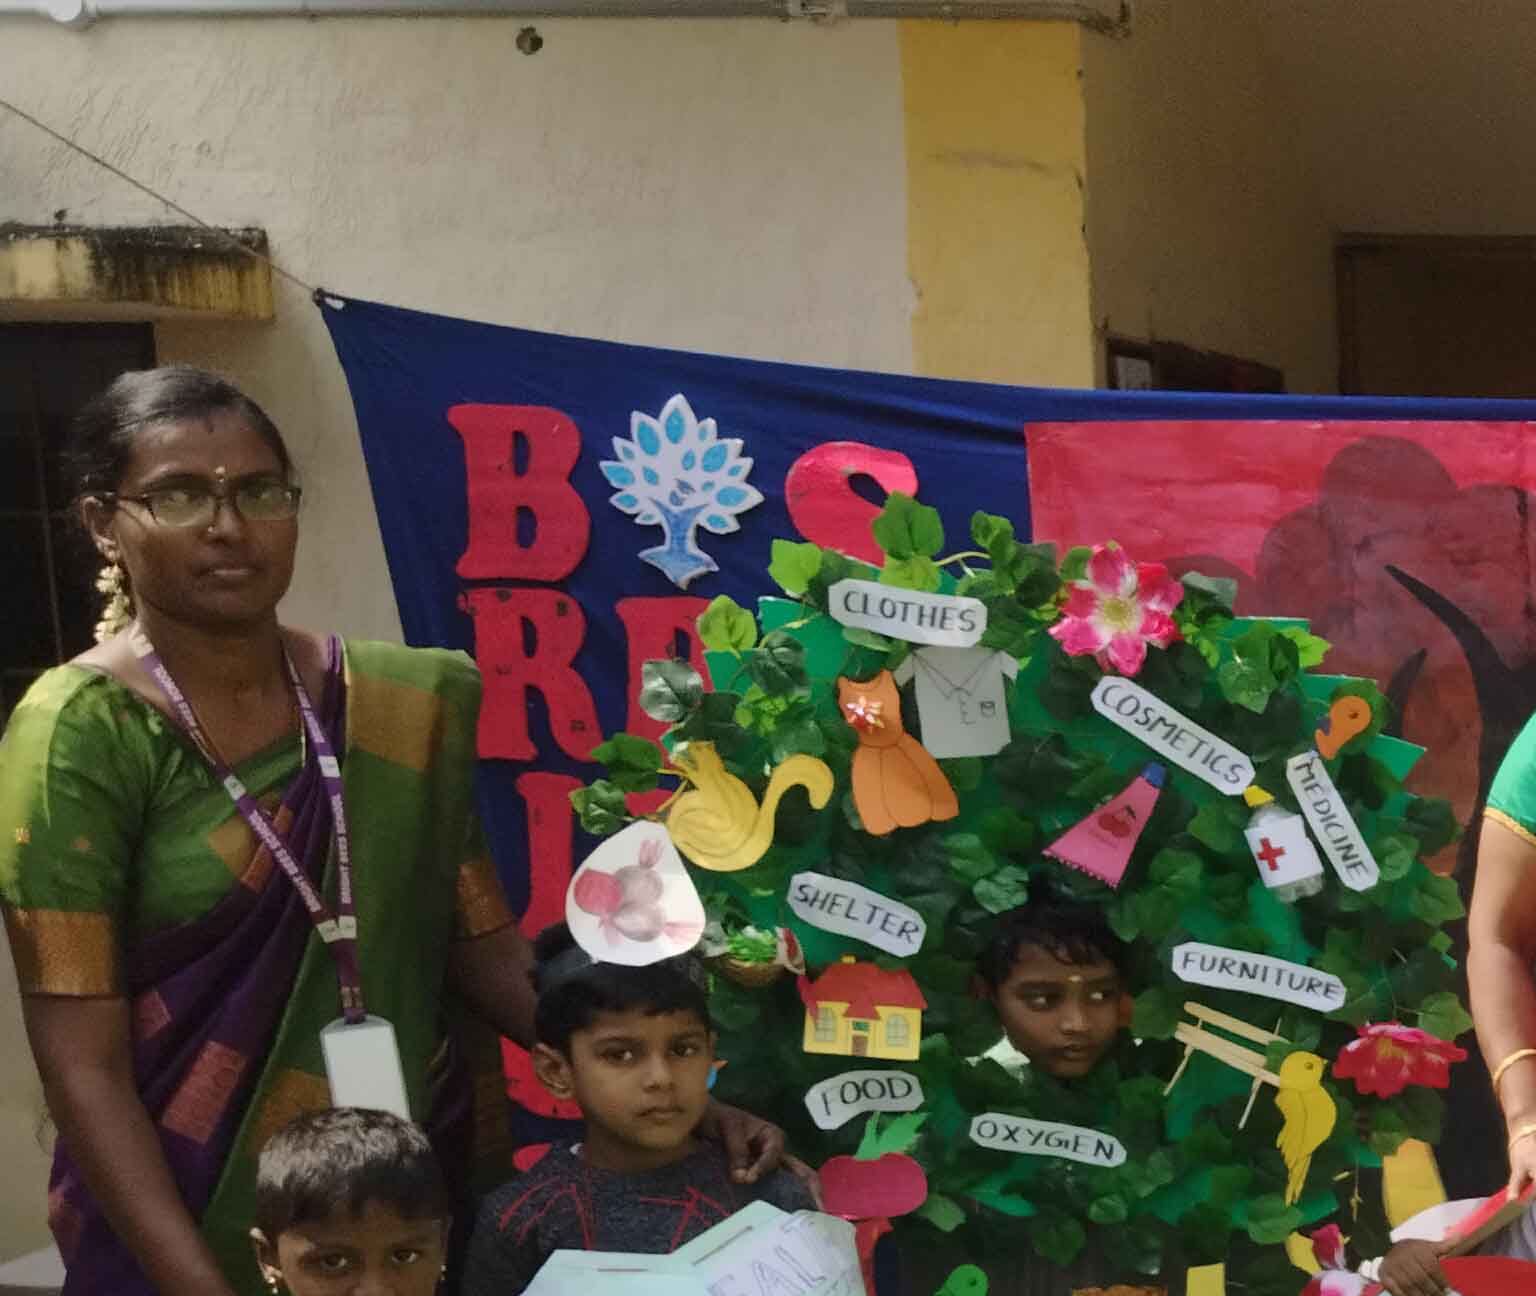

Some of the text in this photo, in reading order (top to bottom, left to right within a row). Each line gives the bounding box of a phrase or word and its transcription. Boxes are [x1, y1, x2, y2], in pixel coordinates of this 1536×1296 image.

[843, 591, 977, 633] CLOTHES
[1100, 683, 1242, 786] COSMETICS
[1295, 754, 1369, 878] MEDICINE
[796, 883, 921, 945] SHELTER
[1182, 951, 1341, 999] FURNITURE
[976, 1119, 1116, 1161] OXYGEN
